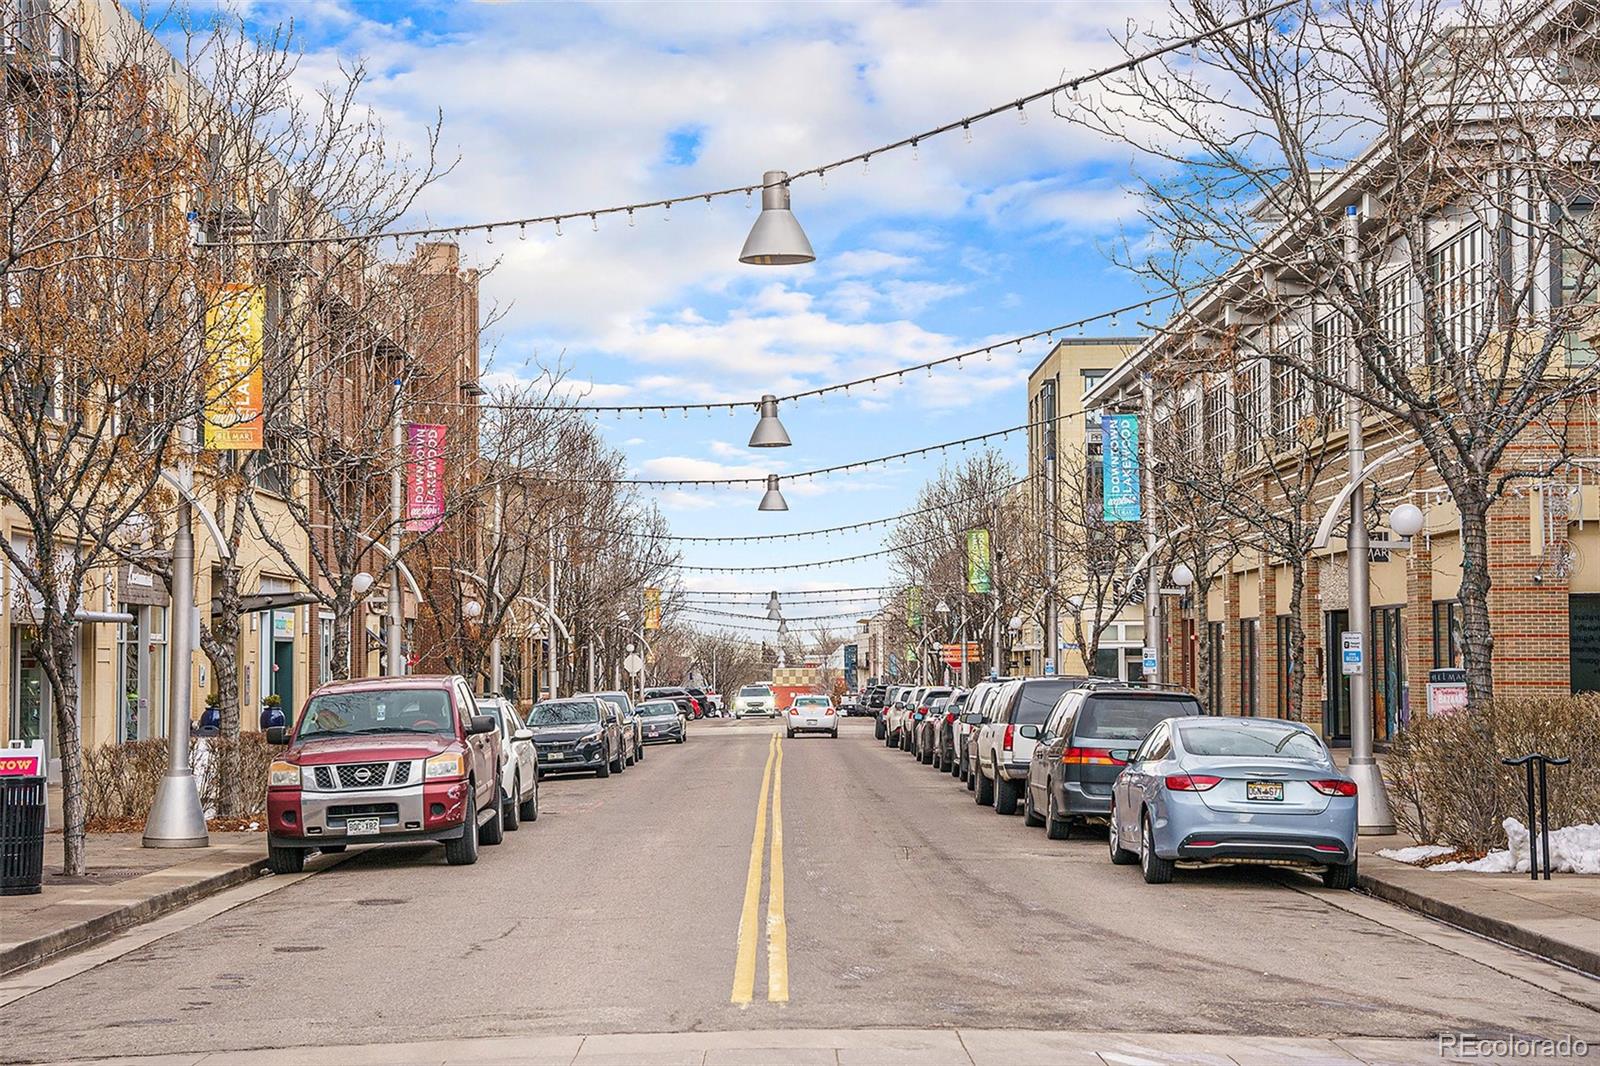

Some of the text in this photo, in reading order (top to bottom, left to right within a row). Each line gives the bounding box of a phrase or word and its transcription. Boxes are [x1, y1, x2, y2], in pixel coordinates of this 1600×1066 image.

[426, 429, 438, 503] LAKEWOOD
[1109, 419, 1121, 493] DOWNTOWN
[1121, 419, 1133, 493] LAKEWOOD
